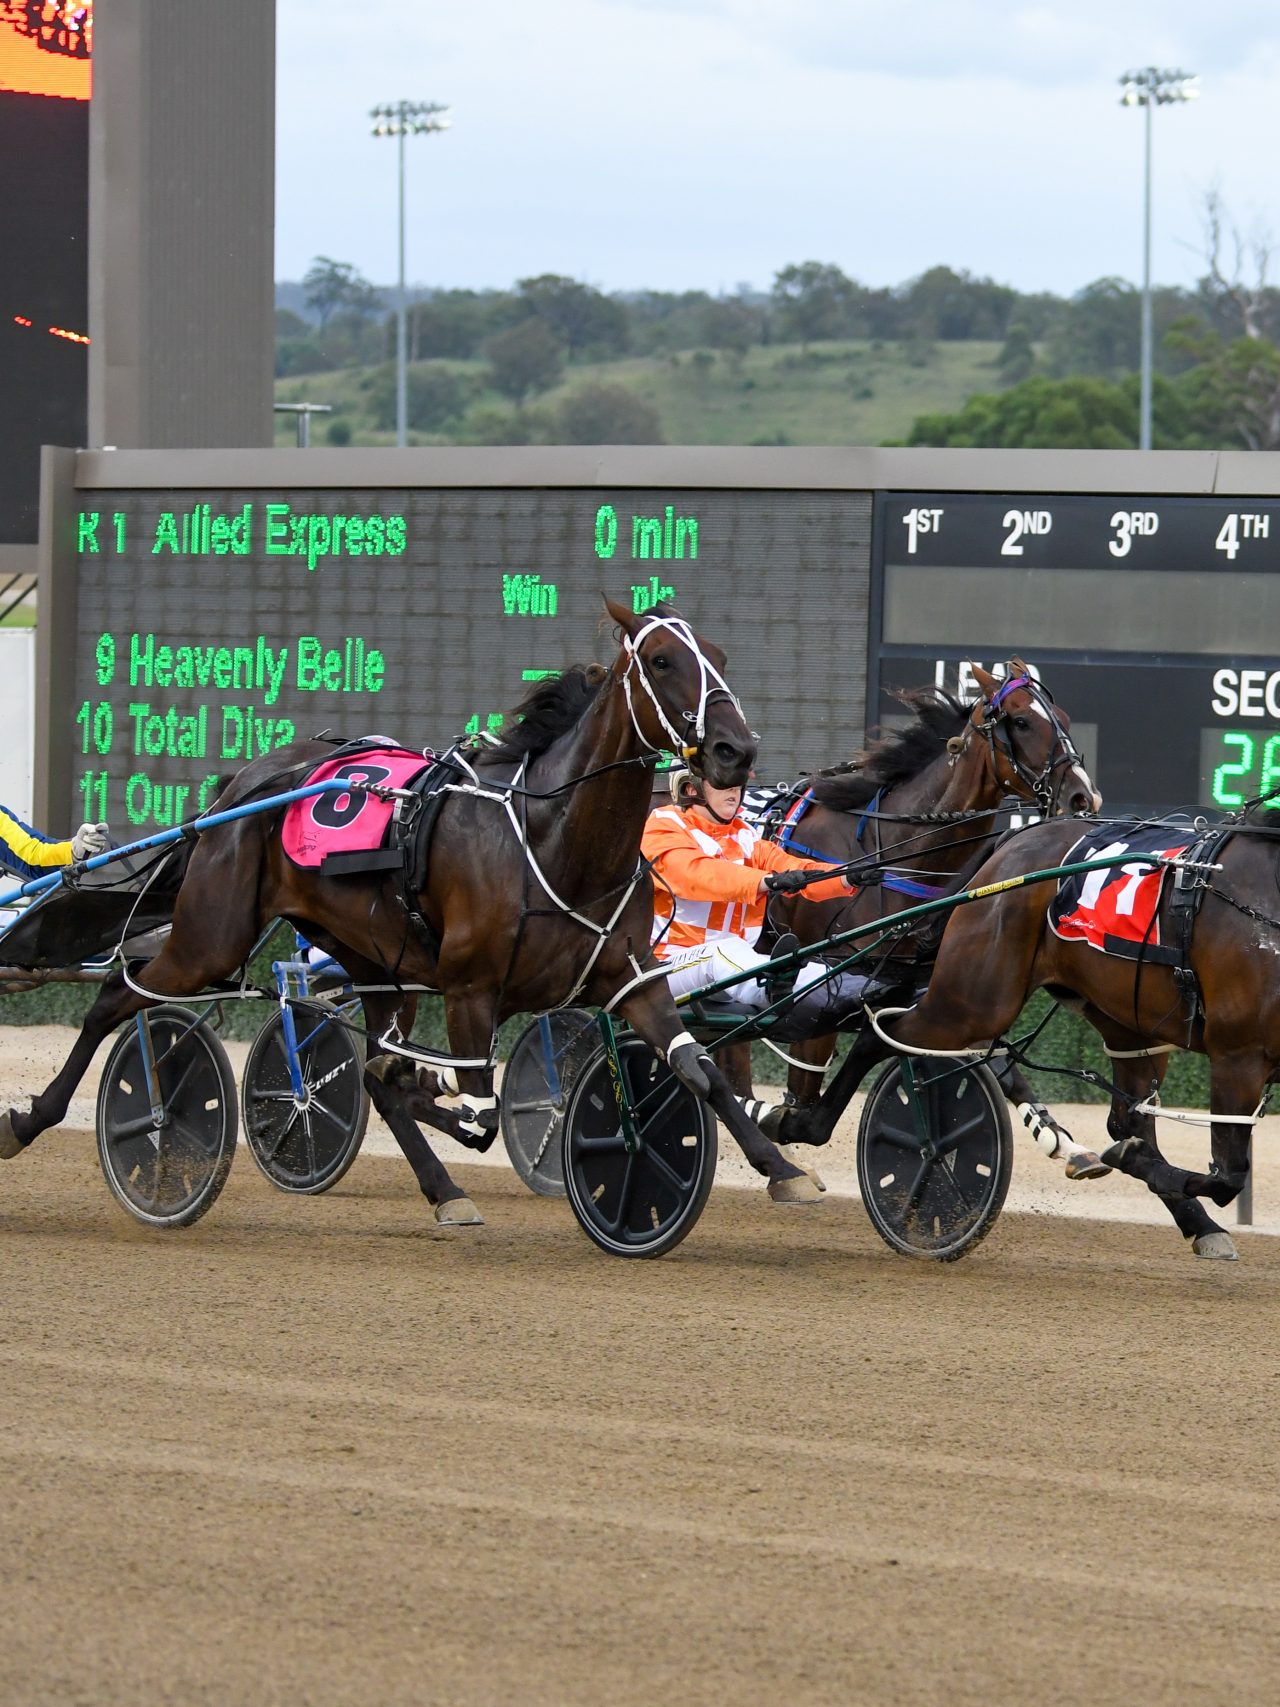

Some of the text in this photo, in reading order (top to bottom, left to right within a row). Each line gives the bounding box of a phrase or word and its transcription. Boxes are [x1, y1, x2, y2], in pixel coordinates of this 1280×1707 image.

[112, 512, 127, 554] 1
[151, 504, 253, 555] Allied
[264, 503, 408, 571] Express
[594, 504, 699, 559] 0 min
[902, 508, 944, 554] 1ST
[1001, 509, 1053, 556] 2ND
[1108, 511, 1159, 557] 3RD
[1215, 513, 1270, 560] 4TH
[502, 573, 559, 617] Win
[95, 632, 386, 706] 9 Heavenly Belle
[76, 701, 114, 755] 10
[128, 702, 209, 758] Total
[78, 770, 110, 823] 11
[125, 772, 191, 827] Our
[310, 763, 392, 830] 8
